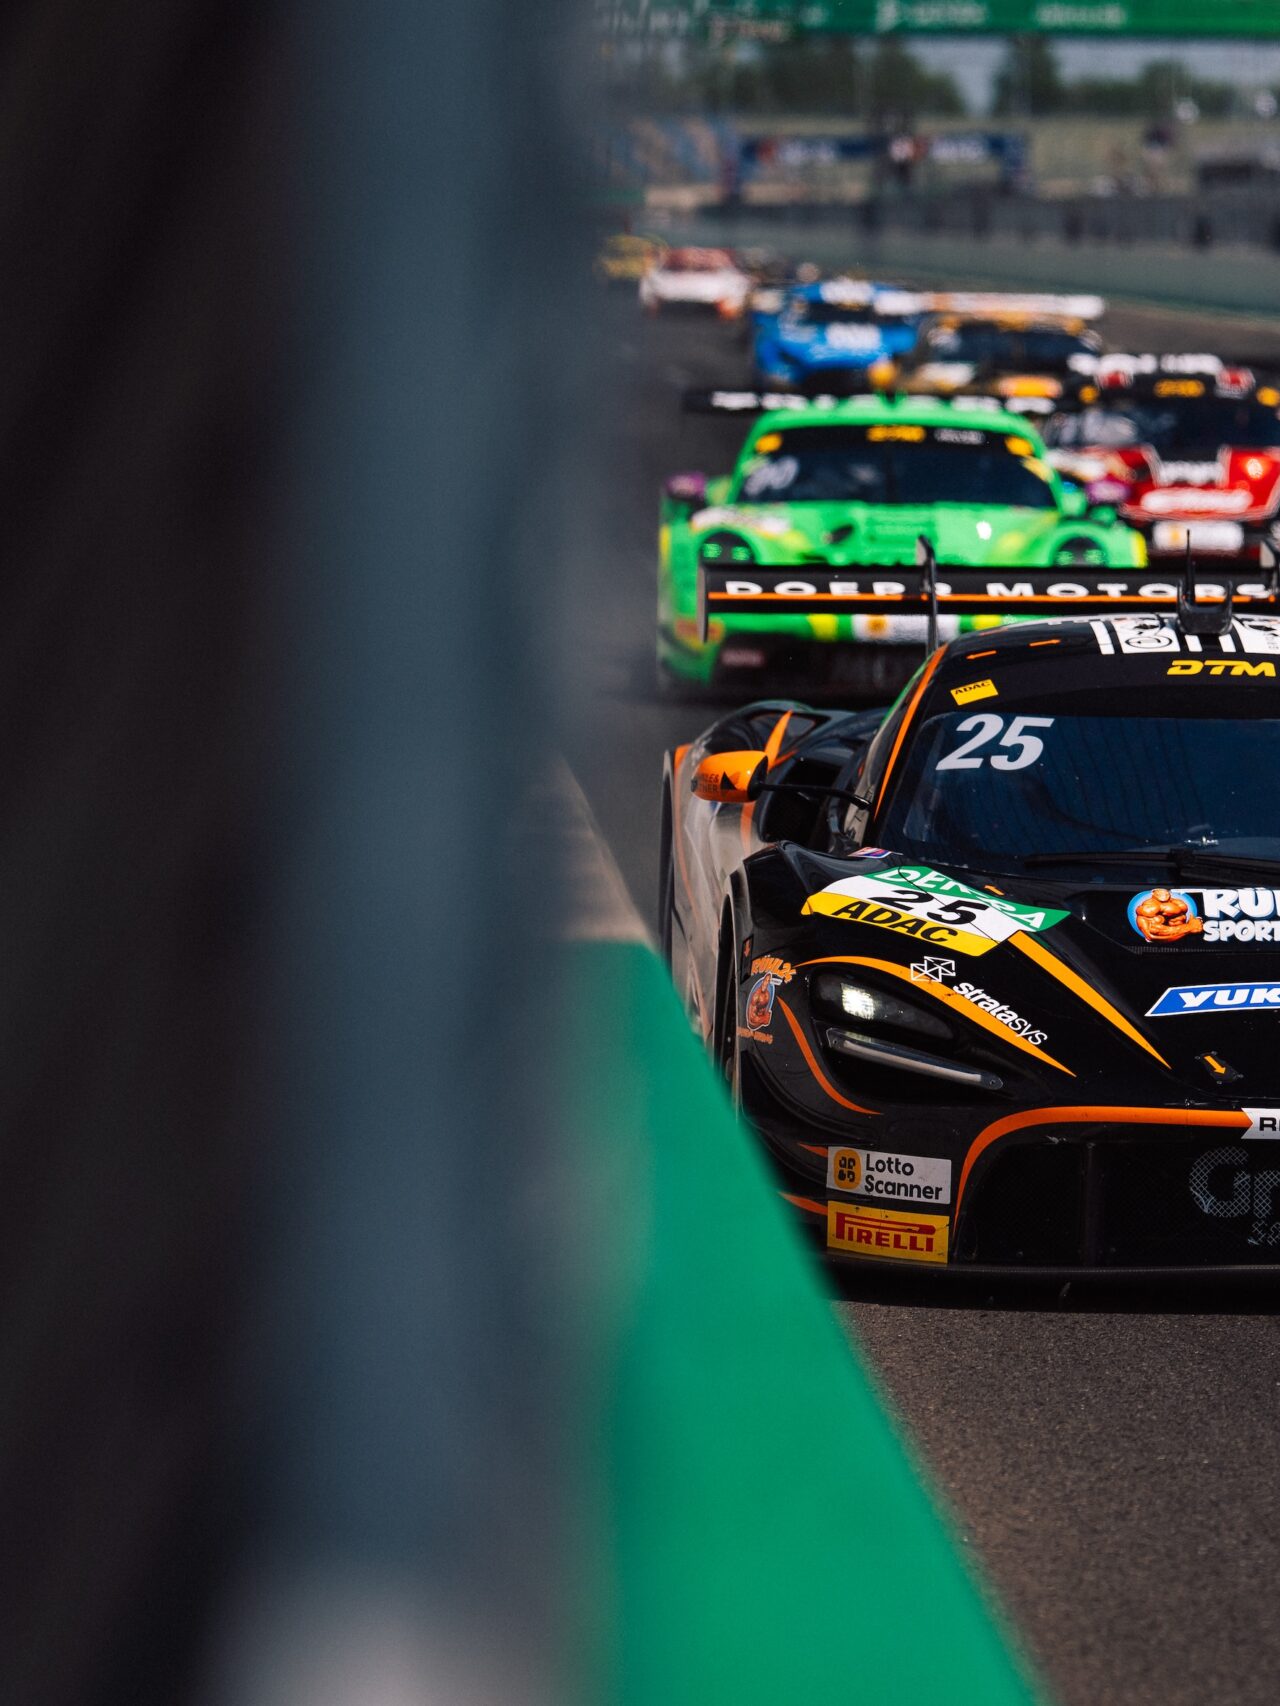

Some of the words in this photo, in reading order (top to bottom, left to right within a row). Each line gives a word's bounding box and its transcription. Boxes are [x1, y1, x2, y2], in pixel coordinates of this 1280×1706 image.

[1167, 660, 1277, 677] DTM
[954, 681, 991, 696] ADAC
[935, 713, 1055, 771] 25
[832, 901, 958, 943] ADAC
[868, 890, 988, 925] 25
[953, 982, 1048, 1046] stratasys
[866, 1154, 914, 1176] Lotto
[864, 1175, 943, 1200] Scanner
[836, 1212, 936, 1252] PIRELLI
